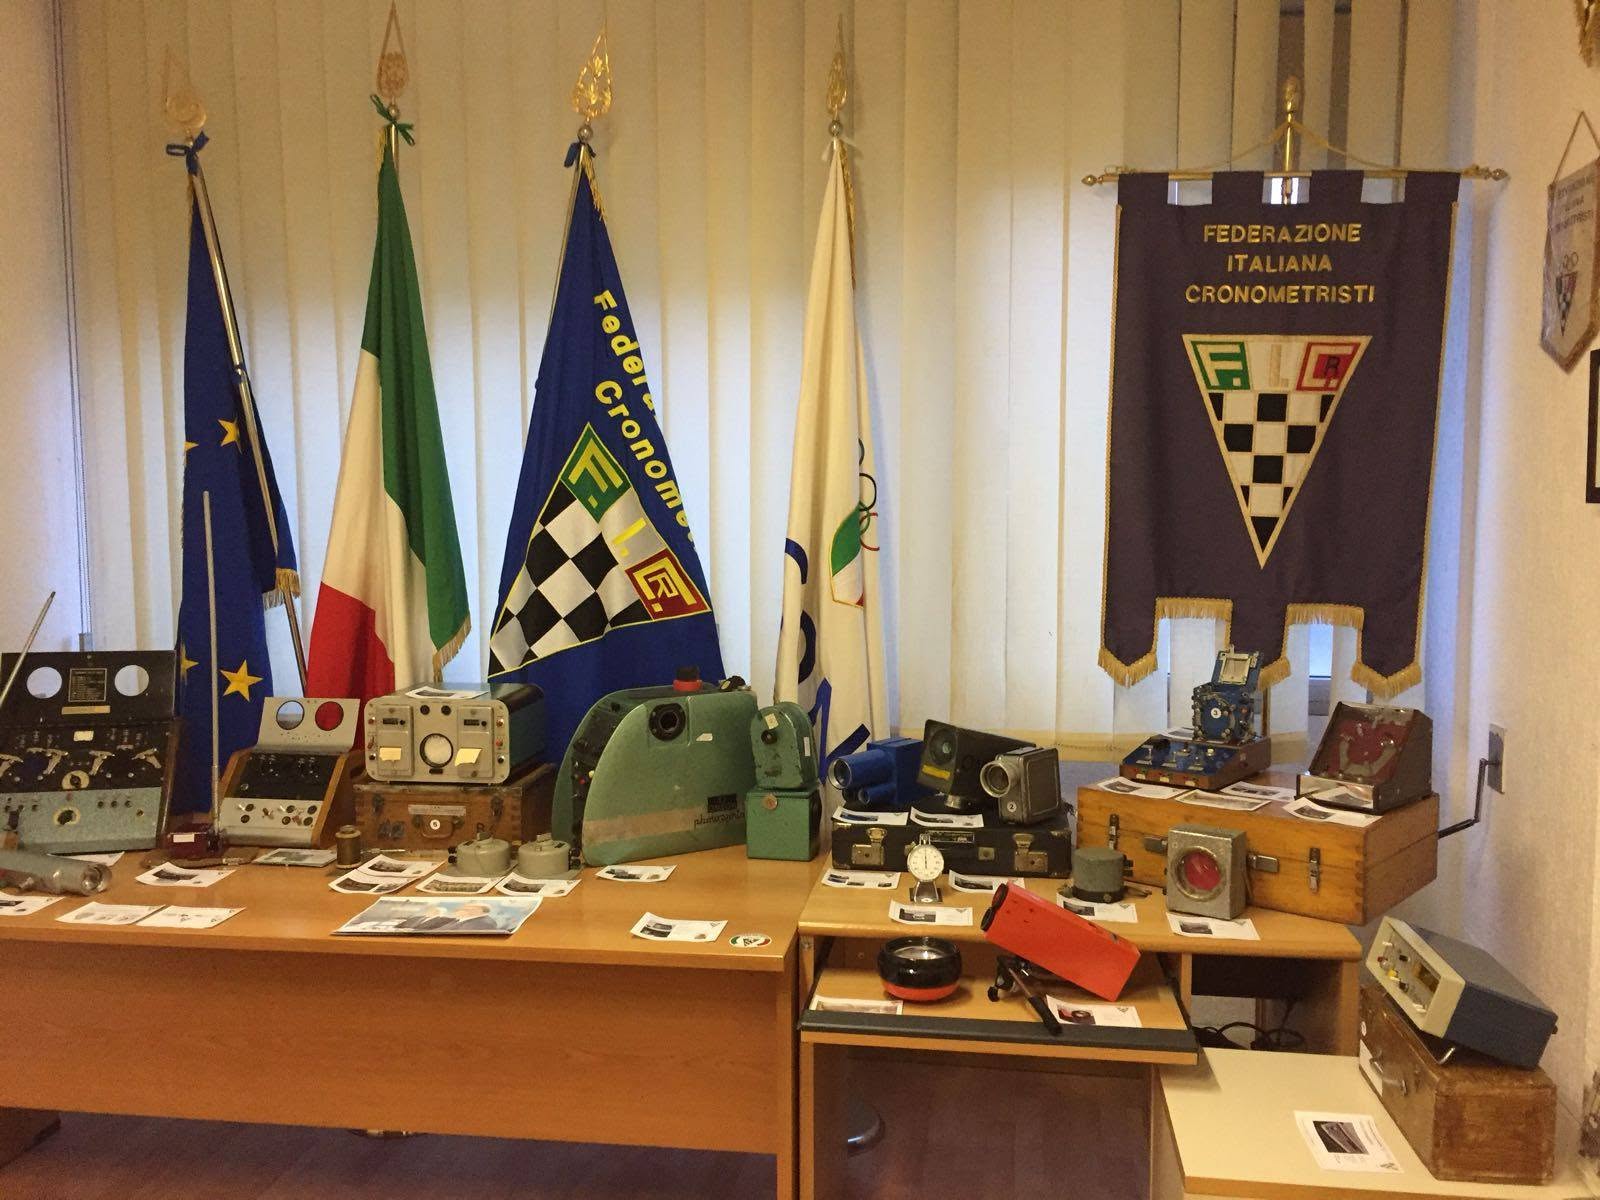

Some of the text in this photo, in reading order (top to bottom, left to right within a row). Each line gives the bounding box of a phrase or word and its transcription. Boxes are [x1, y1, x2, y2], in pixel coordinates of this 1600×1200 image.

[1203, 223, 1362, 243] FEDERAZIONE
[1227, 254, 1333, 273] ITALIANA
[1185, 284, 1376, 304] CRONOMETRISTI
[595, 380, 693, 543] Cronome
